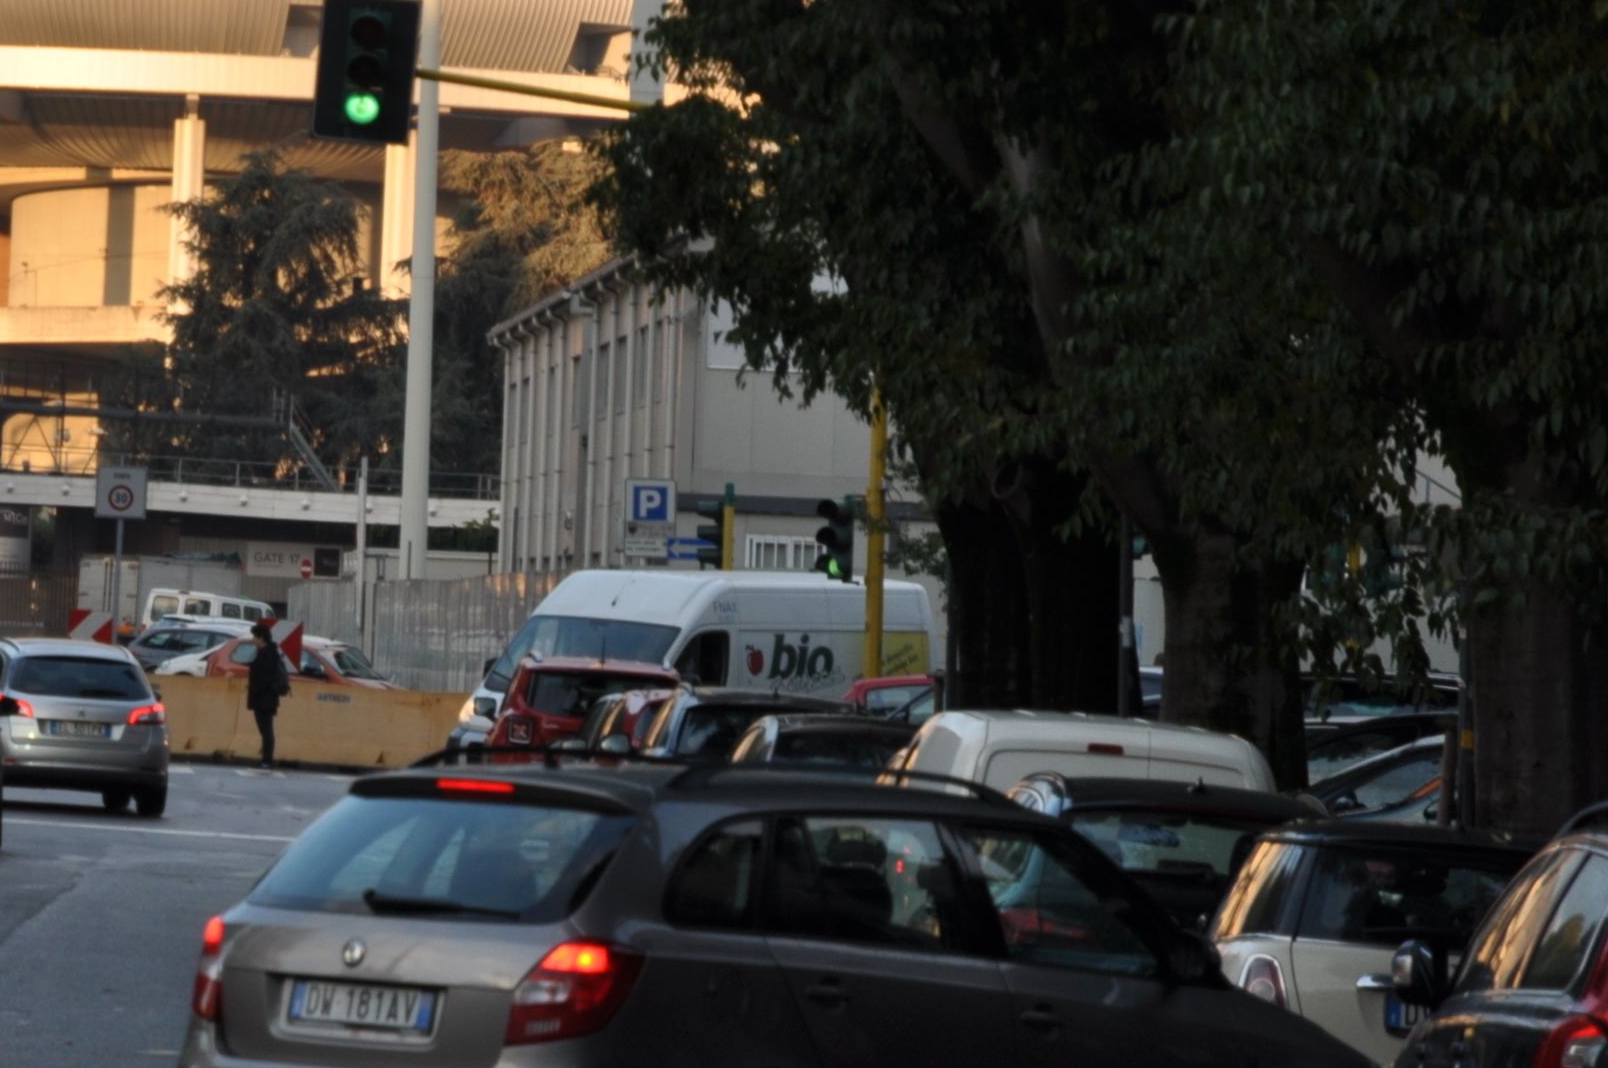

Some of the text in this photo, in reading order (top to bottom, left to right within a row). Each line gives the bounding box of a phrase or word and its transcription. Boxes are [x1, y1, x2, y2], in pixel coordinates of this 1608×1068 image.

[115, 491, 128, 504] 30
[639, 489, 661, 518] P
[254, 552, 301, 565] GATE 17
[767, 633, 834, 679] bio
[306, 985, 419, 1024] DW 181AV
